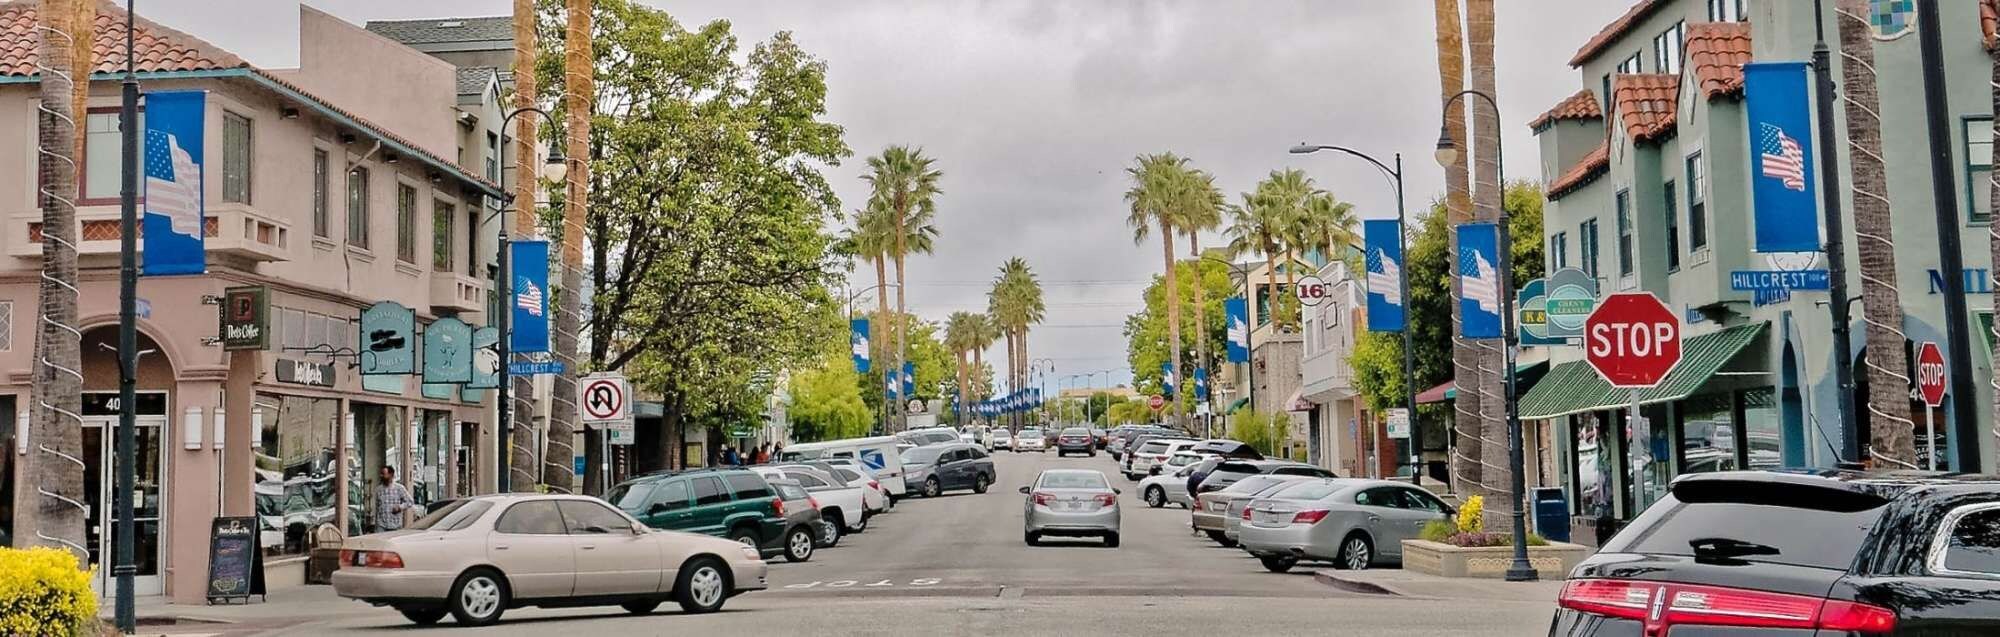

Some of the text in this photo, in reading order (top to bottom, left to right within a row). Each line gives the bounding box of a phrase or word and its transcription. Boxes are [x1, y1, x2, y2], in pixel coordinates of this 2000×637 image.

[1732, 272, 1807, 288] HILLCREST
[1299, 283, 1324, 299] 16
[1592, 322, 1674, 358] STOP
[509, 364, 549, 374] HILLCREST
[1920, 362, 1944, 387] STOP
